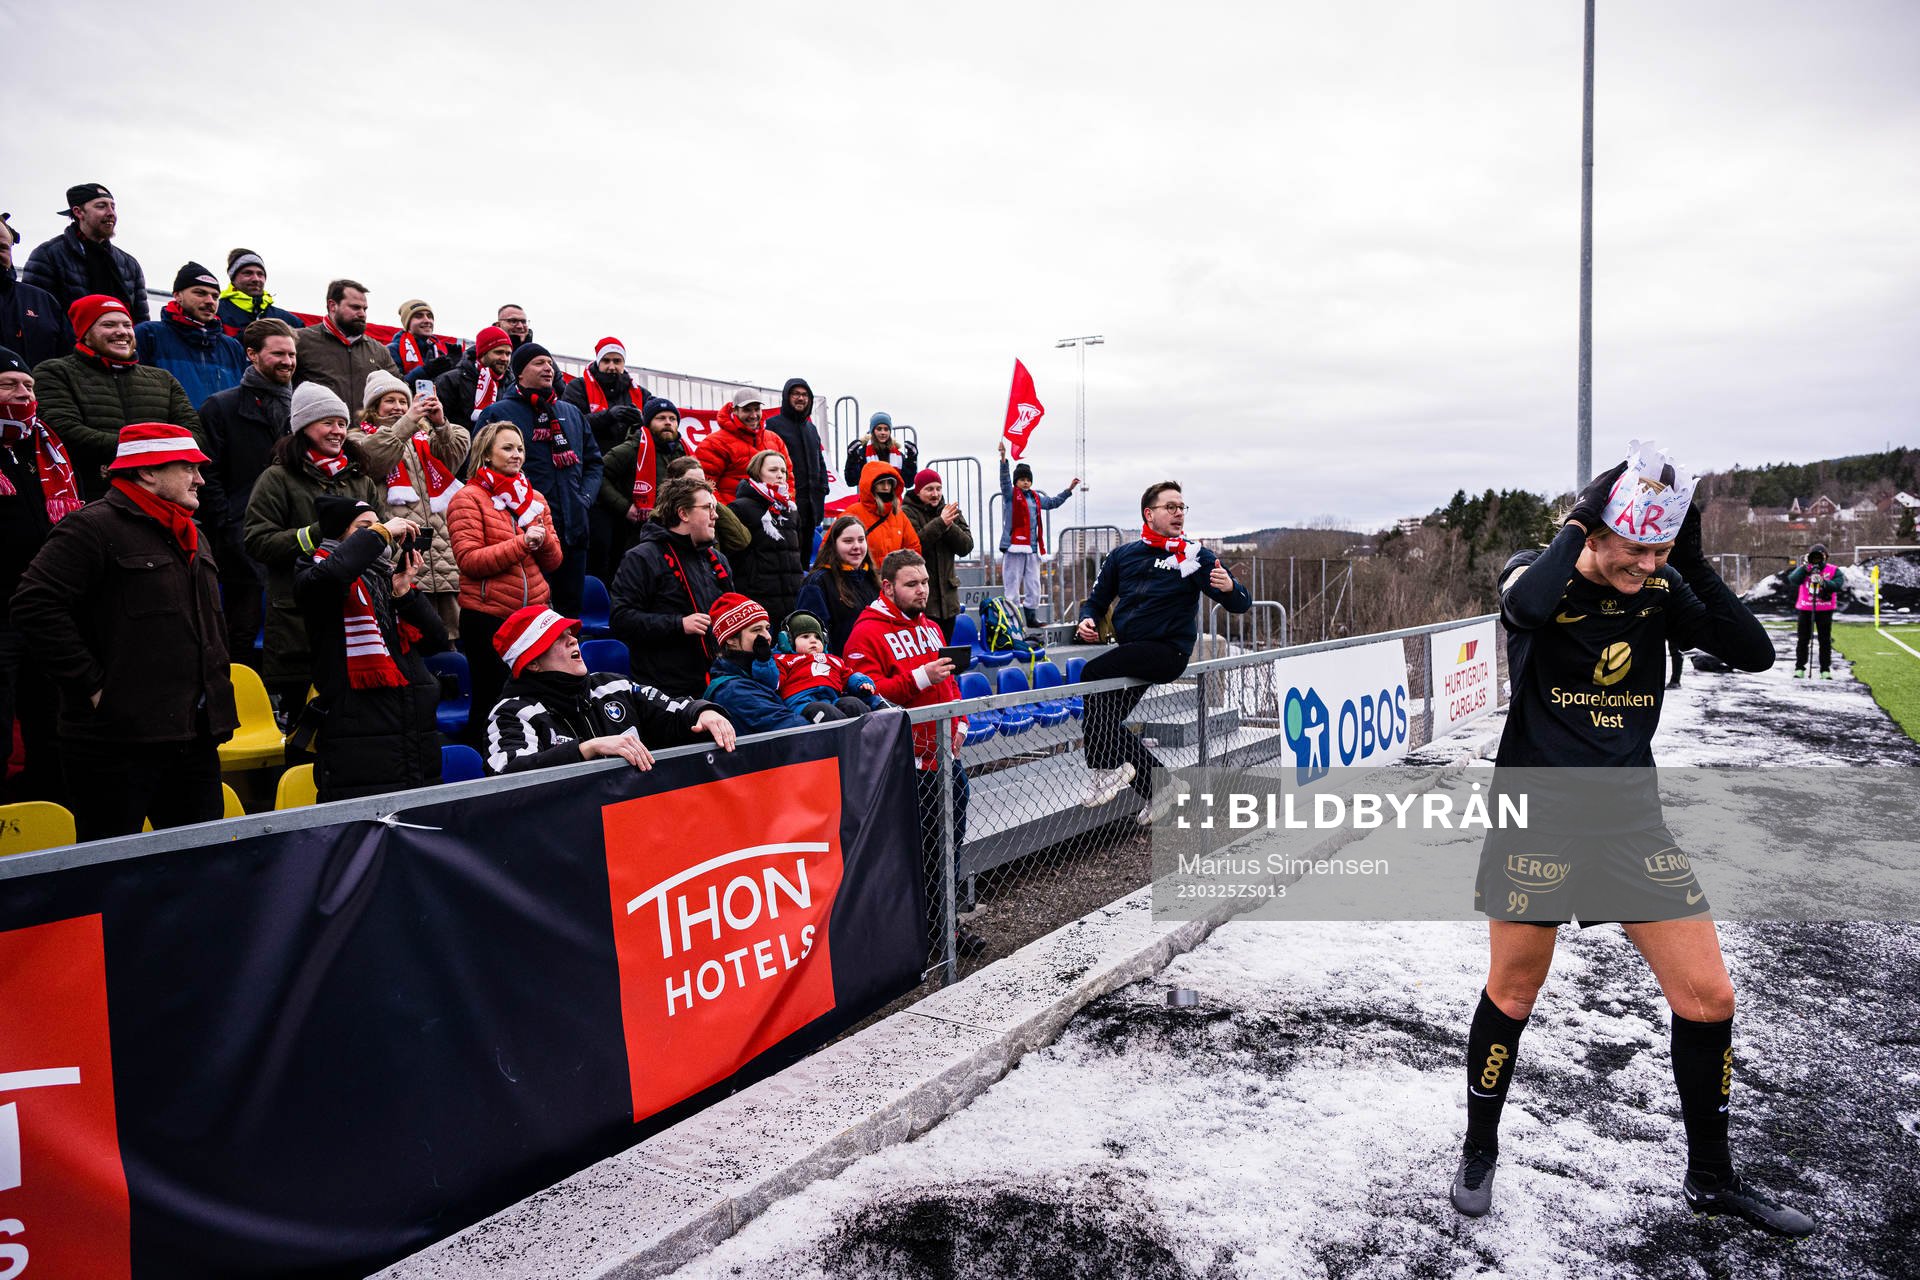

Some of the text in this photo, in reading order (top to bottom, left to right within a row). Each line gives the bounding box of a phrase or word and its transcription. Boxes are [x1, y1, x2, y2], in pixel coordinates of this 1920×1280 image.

[1646, 578, 1669, 588] DEN
[1047, 631, 1062, 643] GM
[1444, 661, 1489, 697] HURTIGRUTA
[1449, 687, 1487, 722] CARGLASS
[1551, 687, 1655, 708] Sparebanken
[1338, 684, 1407, 767] OBOS
[1590, 710, 1624, 728] Vest
[1507, 854, 1568, 880] LERØY
[1644, 853, 1690, 872] LERØ
[627, 842, 829, 959] THON
[1506, 891, 1529, 915] 99
[665, 924, 816, 1017] HOTELS
[1480, 1043, 1510, 1089] coop
